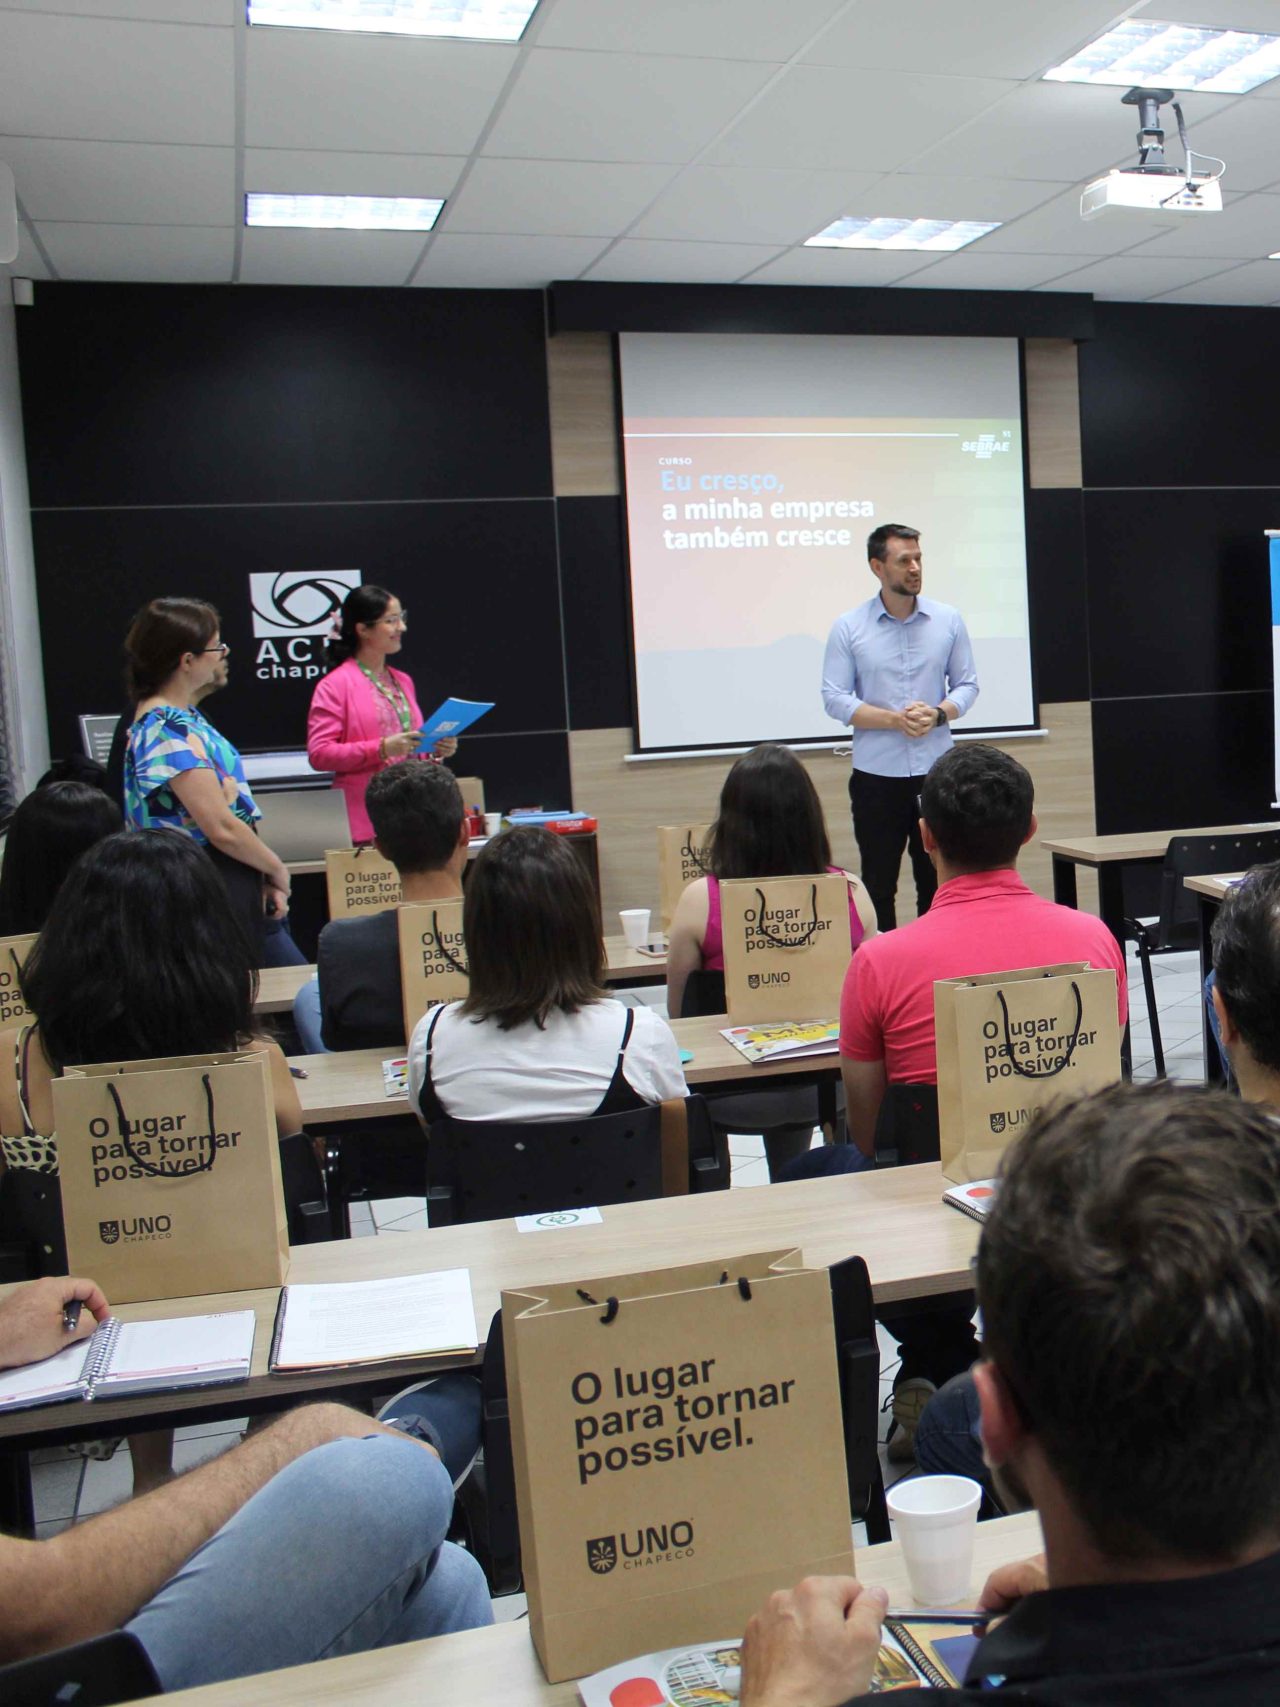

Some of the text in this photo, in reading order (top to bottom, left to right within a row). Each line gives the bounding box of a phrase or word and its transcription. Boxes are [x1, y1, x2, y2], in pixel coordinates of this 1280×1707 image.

[961, 441, 1010, 452] SEBRAE
[658, 457, 692, 466] CURSO
[660, 470, 785, 496] Eu cresço,
[662, 497, 875, 523] a minha empresa
[663, 526, 851, 550] também cresce
[681, 846, 690, 857] O
[345, 870, 392, 885] O lugar
[345, 884, 375, 896] para
[744, 909, 756, 922] O
[422, 932, 433, 945] O
[761, 972, 791, 984] UNO
[983, 1021, 998, 1039] O
[89, 1117, 110, 1138] O
[121, 1215, 171, 1236] UNO
[571, 1358, 716, 1405] O lugar
[574, 1379, 795, 1449] para tornar
[577, 1417, 754, 1485] possível.
[620, 1520, 694, 1558] UNO
